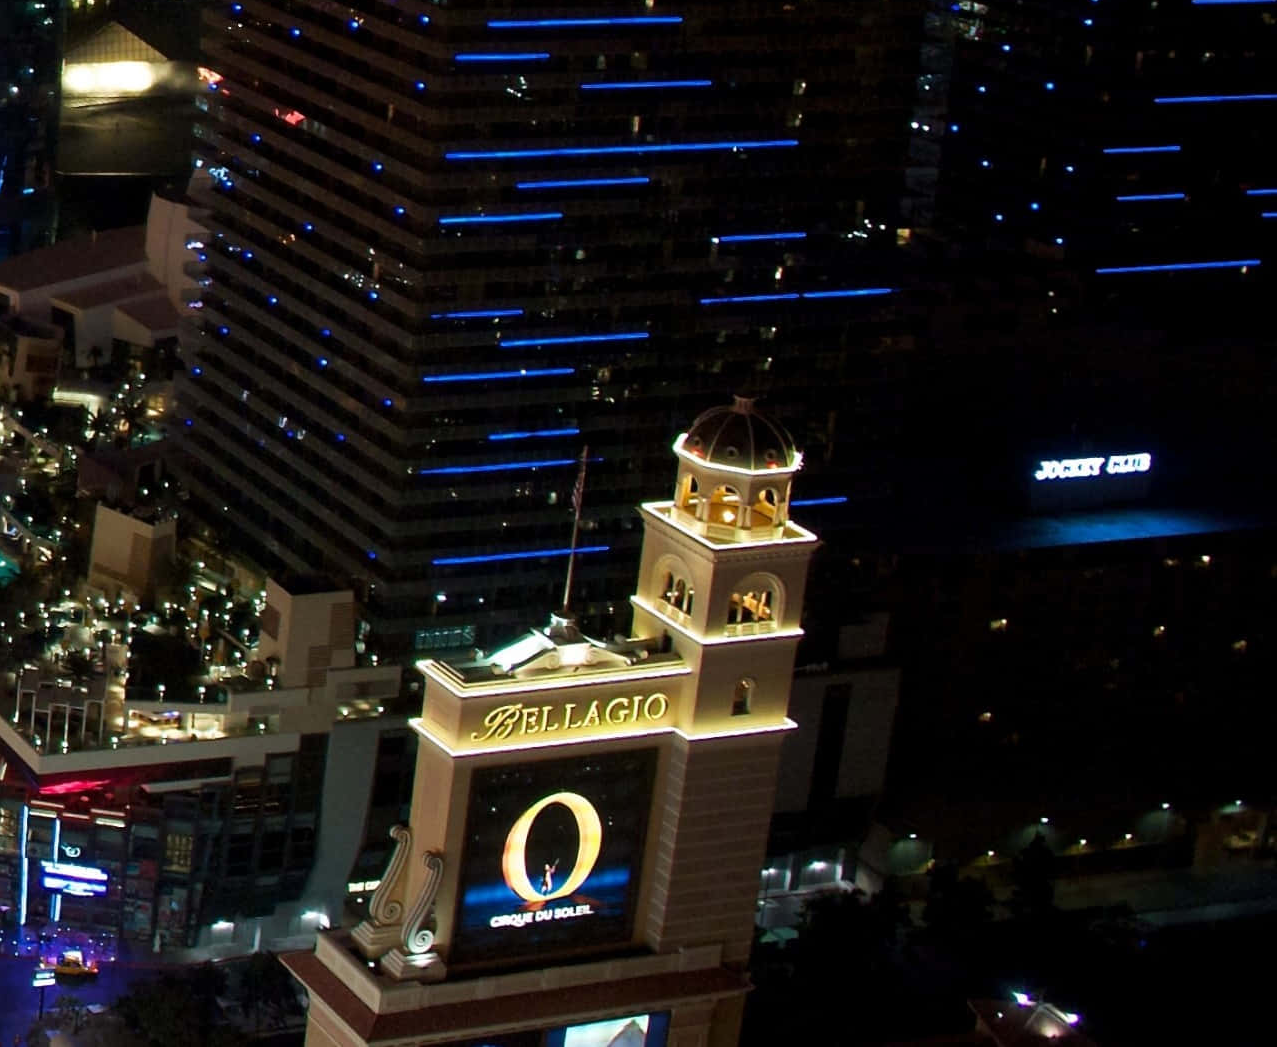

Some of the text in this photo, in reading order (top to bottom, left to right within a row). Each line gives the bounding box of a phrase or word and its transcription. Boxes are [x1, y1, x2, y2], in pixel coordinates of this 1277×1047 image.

[1035, 453, 1151, 480] JOCKEY CLUB
[470, 692, 669, 742] BELLAGIO
[502, 791, 603, 902] O
[490, 912, 534, 928] CIRQUE
[535, 909, 553, 922] DU
